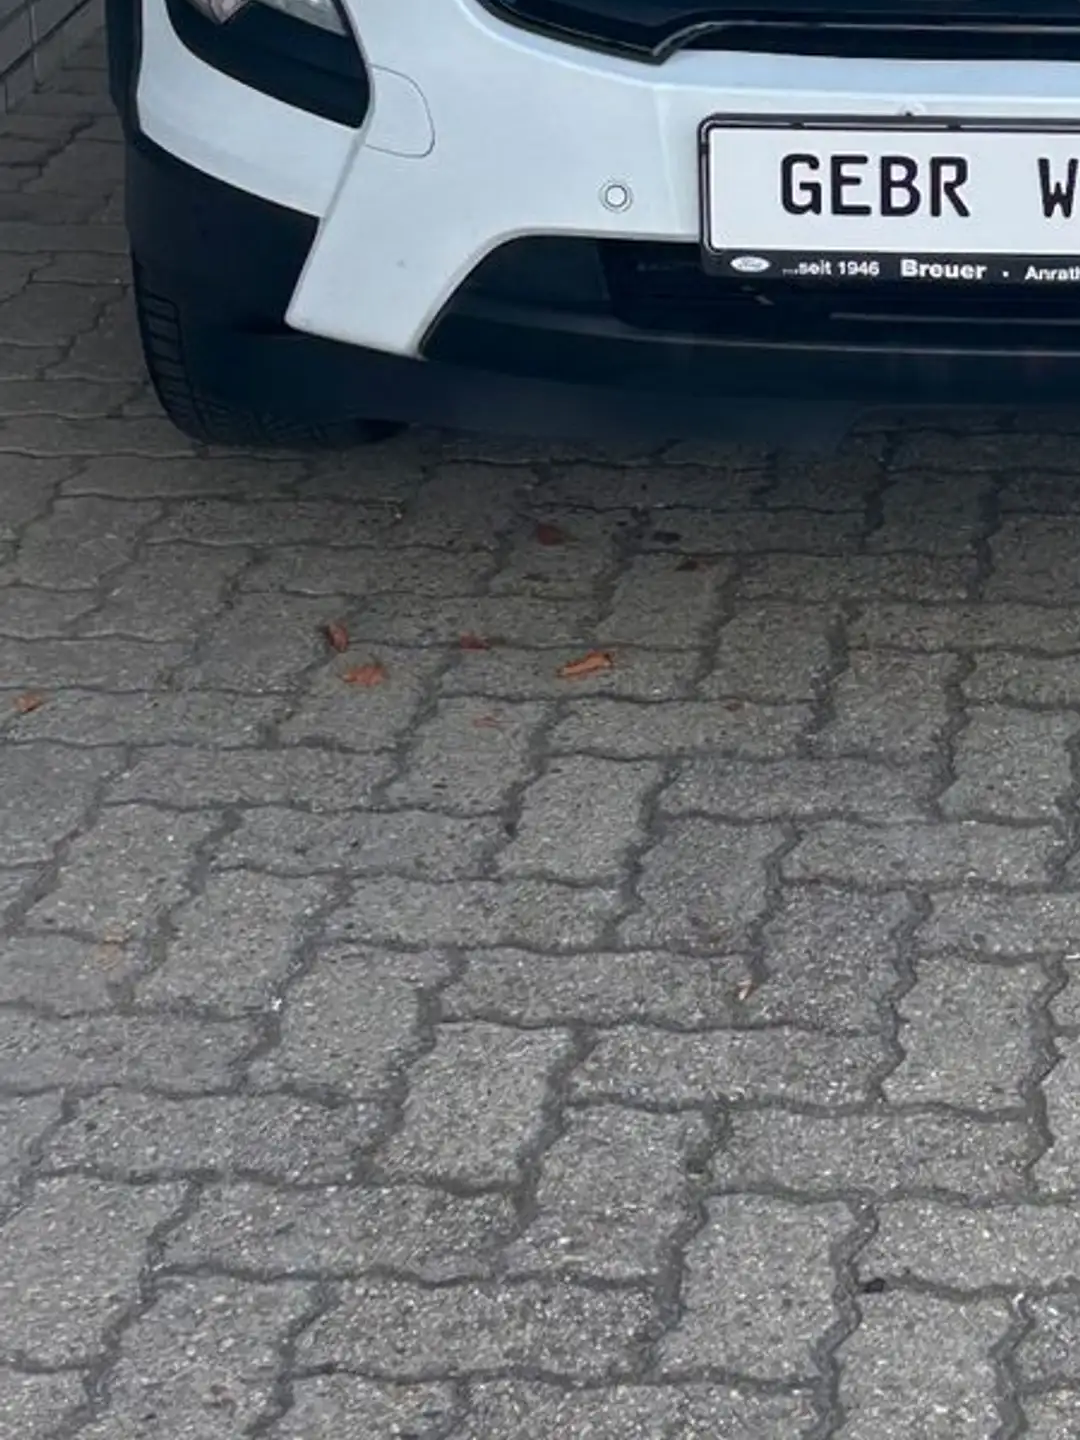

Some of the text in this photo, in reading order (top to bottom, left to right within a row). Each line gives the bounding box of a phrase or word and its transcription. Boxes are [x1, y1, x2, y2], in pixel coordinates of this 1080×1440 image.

[780, 153, 971, 218] GEBR
[838, 260, 881, 277] 1946
[900, 259, 988, 280] Breuer
